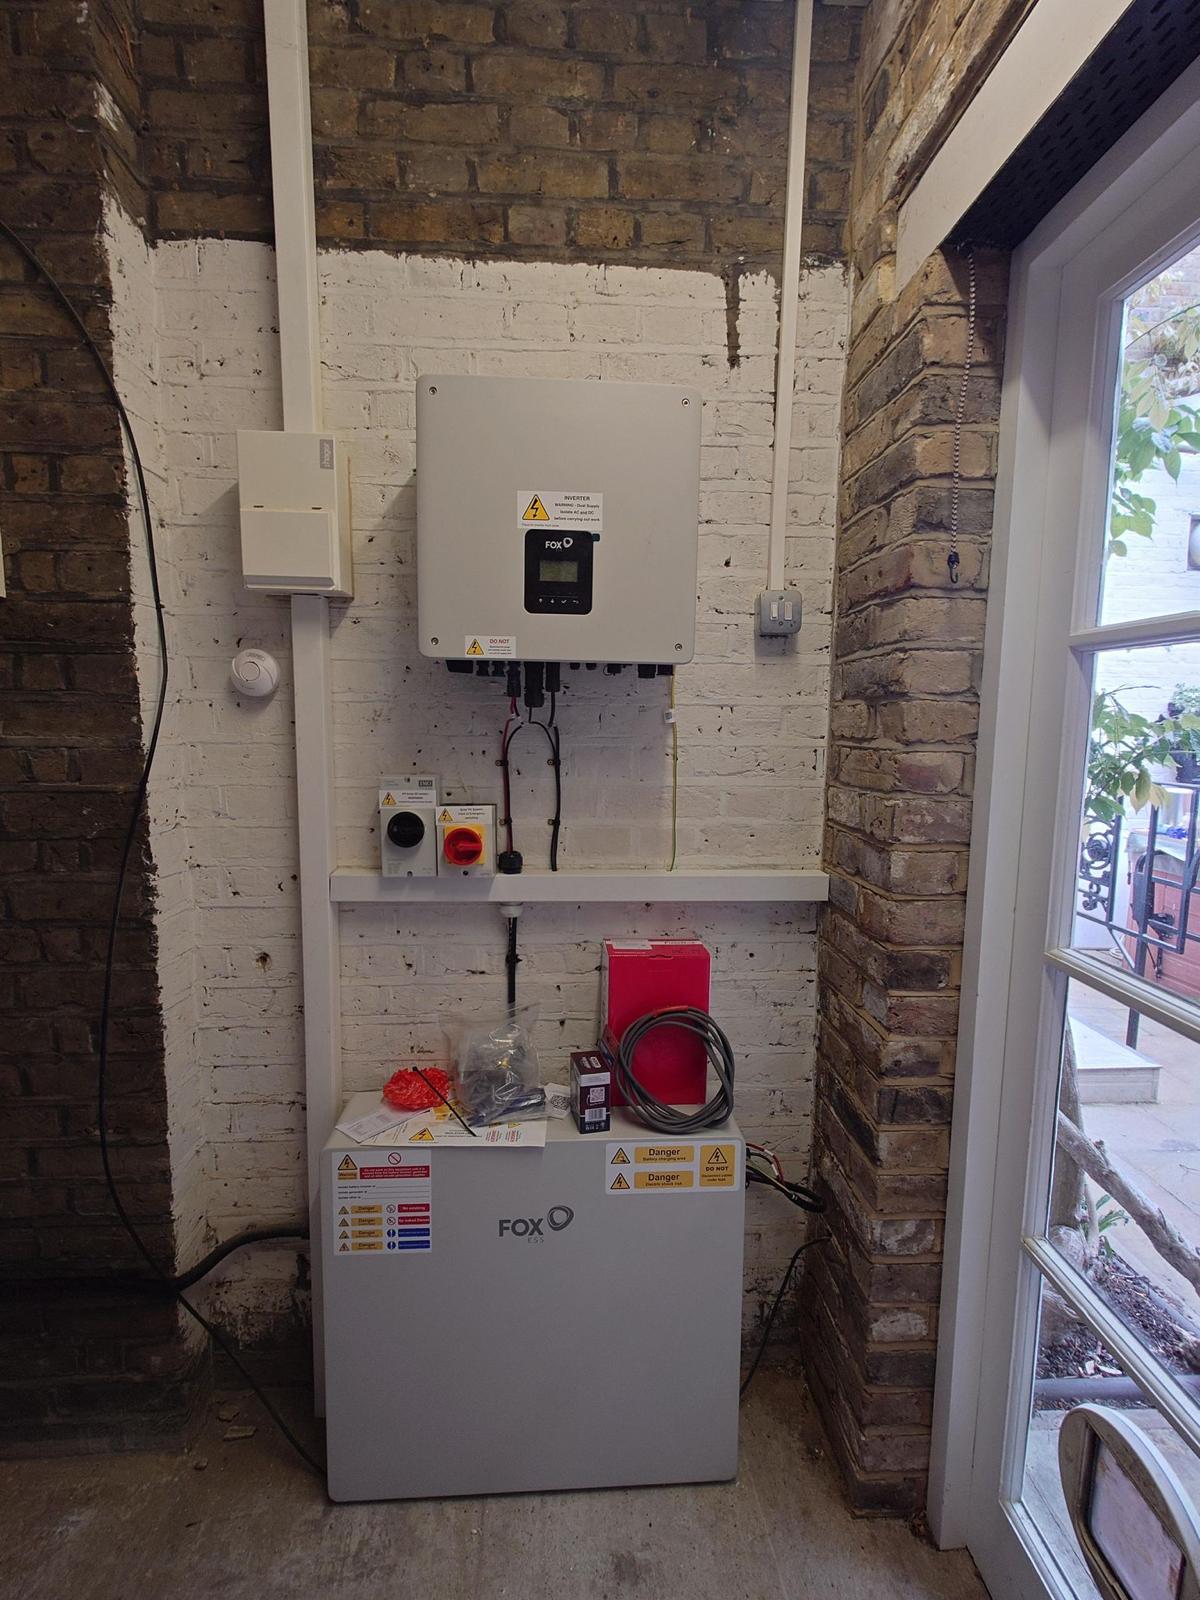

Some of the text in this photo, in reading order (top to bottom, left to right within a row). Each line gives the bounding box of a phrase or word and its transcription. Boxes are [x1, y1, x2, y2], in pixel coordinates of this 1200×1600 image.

[545, 541, 562, 549] FOX
[648, 1148, 681, 1157] Danger
[648, 1173, 680, 1182] Danger
[499, 1218, 544, 1237] FOX
